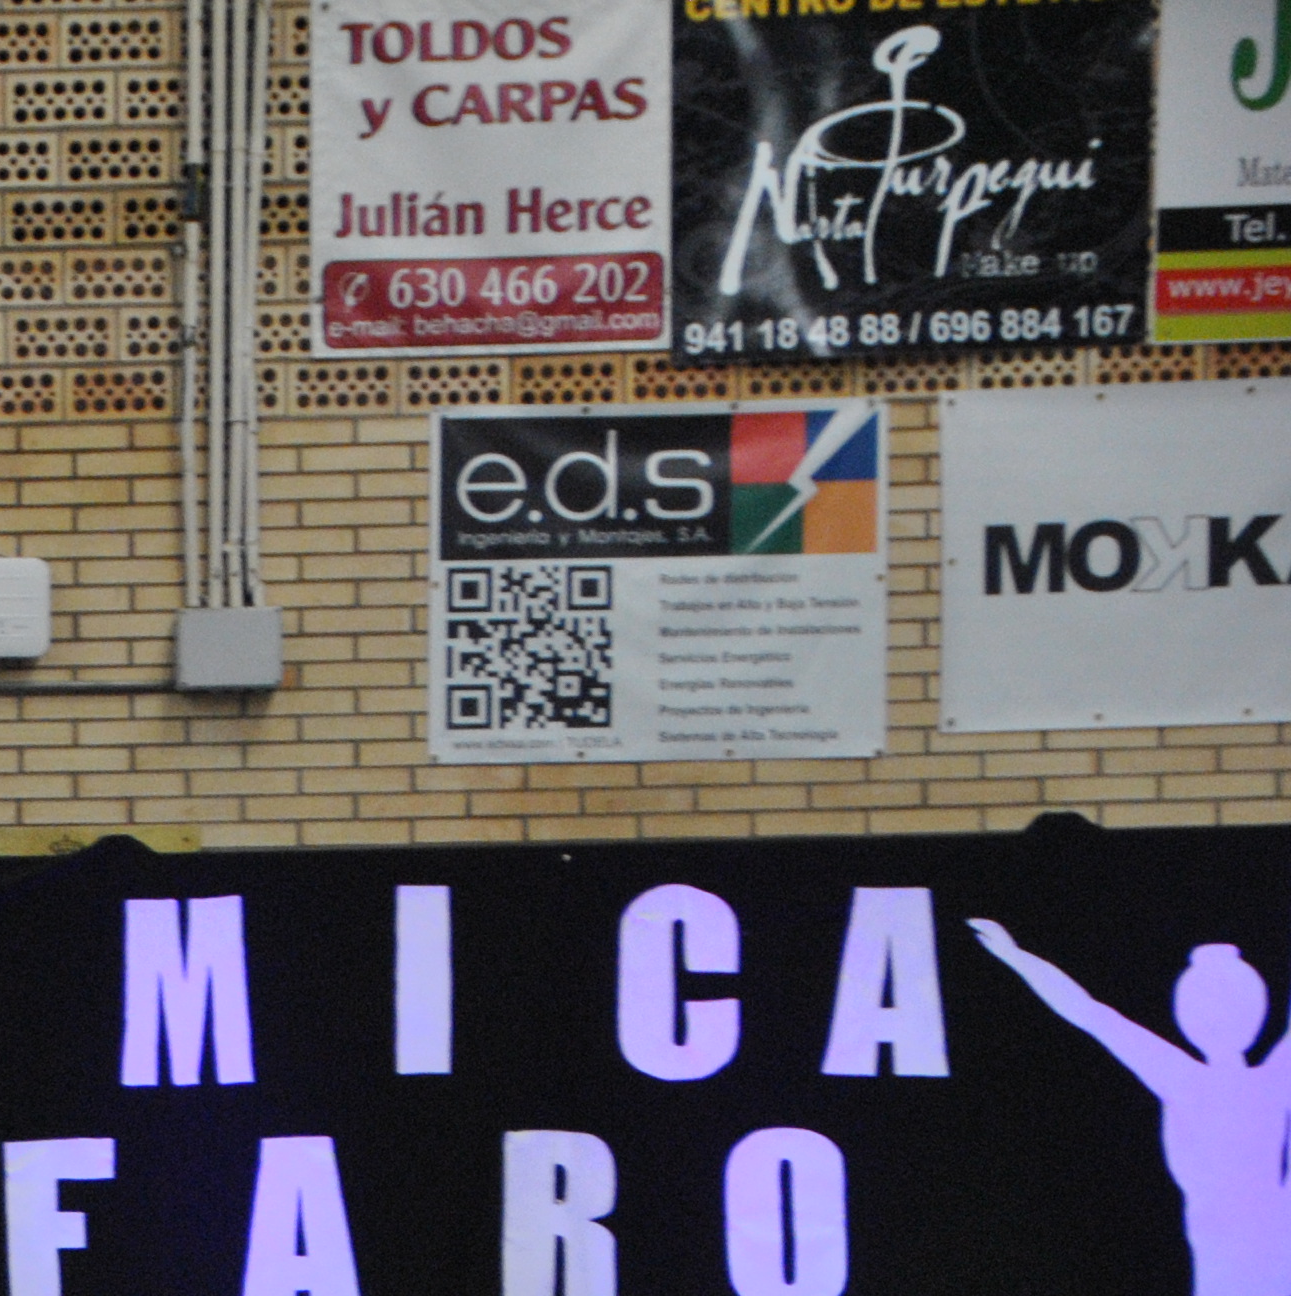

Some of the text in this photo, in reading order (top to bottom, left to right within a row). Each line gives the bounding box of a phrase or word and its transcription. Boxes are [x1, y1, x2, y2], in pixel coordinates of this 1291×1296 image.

[340, 16, 572, 65] TOLDOS
[359, 78, 648, 140] y CARPAS
[336, 187, 652, 238] Julián Herce
[1224, 212, 1286, 244] Tel.
[388, 261, 650, 309] 630 466 202
[685, 320, 744, 355] 941
[758, 318, 798, 350] 18
[806, 315, 850, 348] 48
[859, 313, 901, 346] 88
[929, 310, 992, 342] 696
[1000, 307, 1061, 340] 884
[1073, 303, 1135, 336] 167
[456, 429, 715, 523] e.d.s
[984, 514, 1291, 595] MOKK
